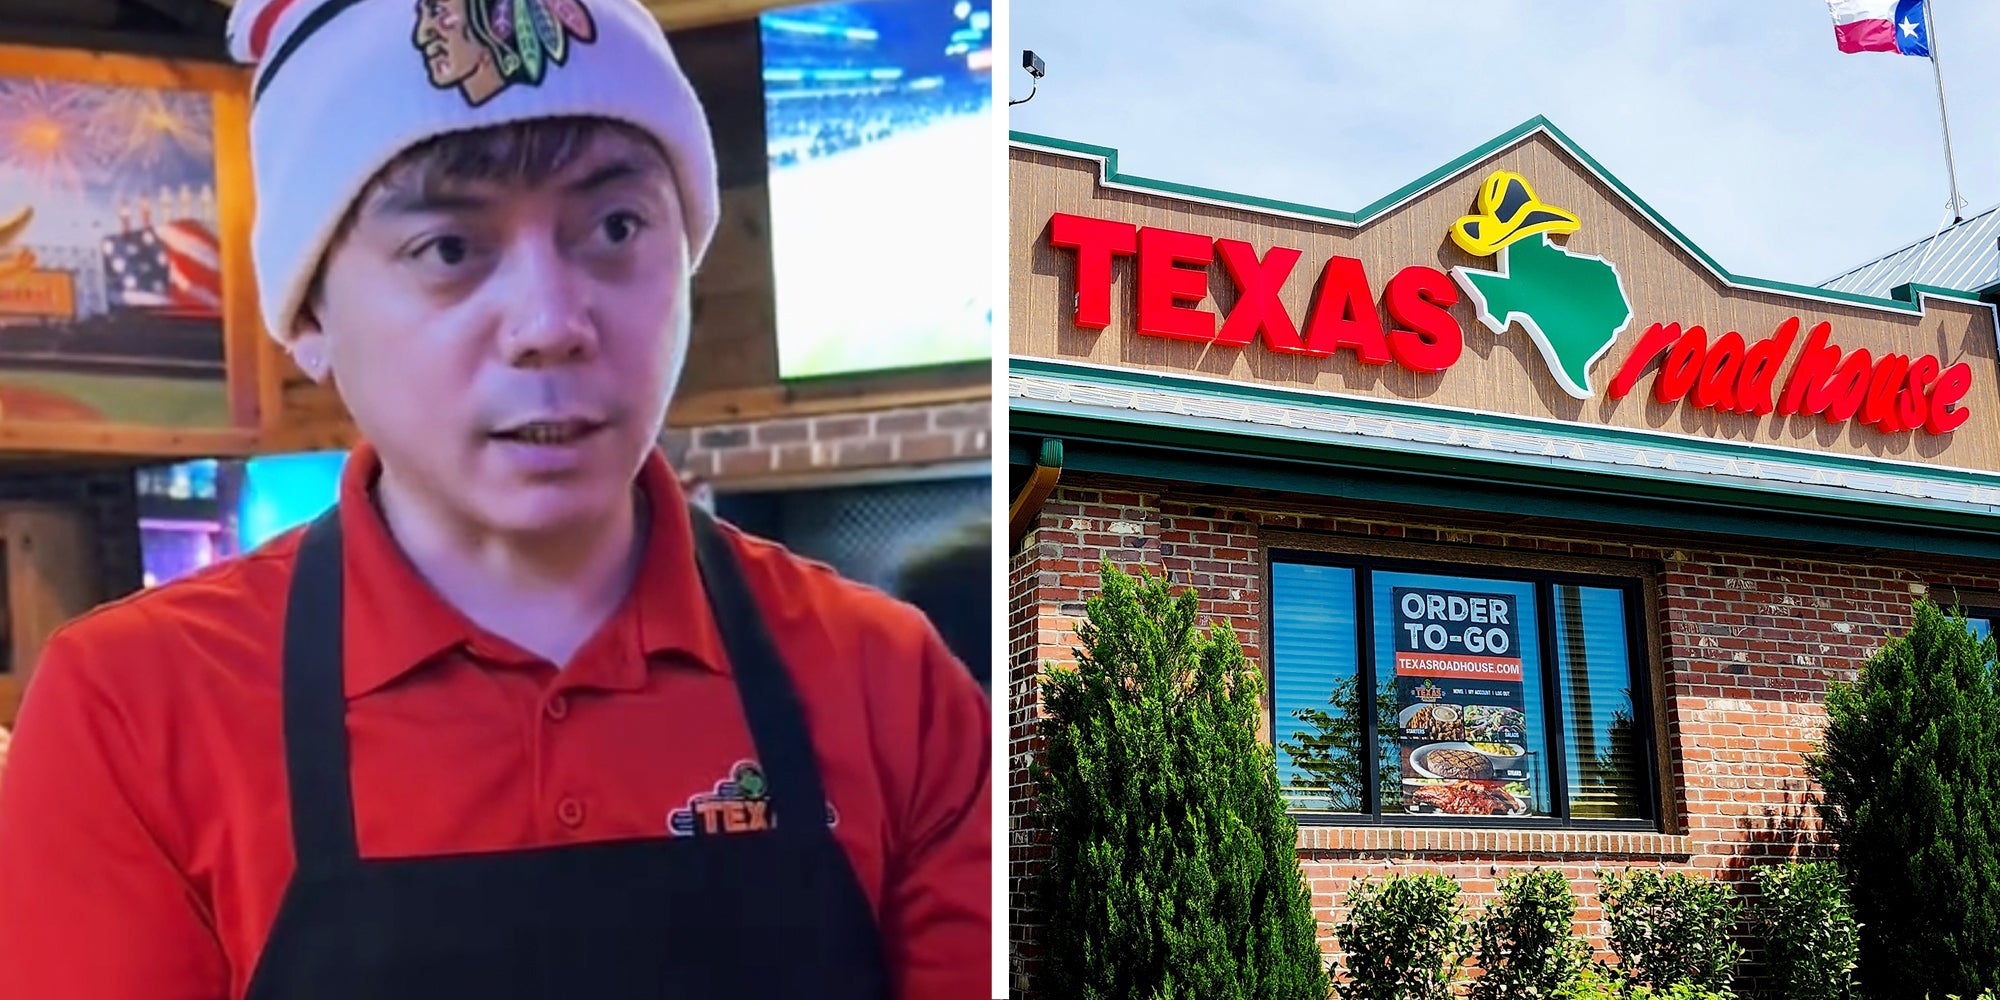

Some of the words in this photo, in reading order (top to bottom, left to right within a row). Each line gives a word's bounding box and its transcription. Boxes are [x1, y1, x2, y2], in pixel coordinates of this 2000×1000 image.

[1050, 212, 1463, 373] TEXAS
[1401, 593, 1510, 625] ORDER
[1404, 623, 1510, 655] TO-GO
[1399, 658, 1520, 675] TEXASROADHOUSE.COM
[1415, 687, 1442, 697] TEXAS
